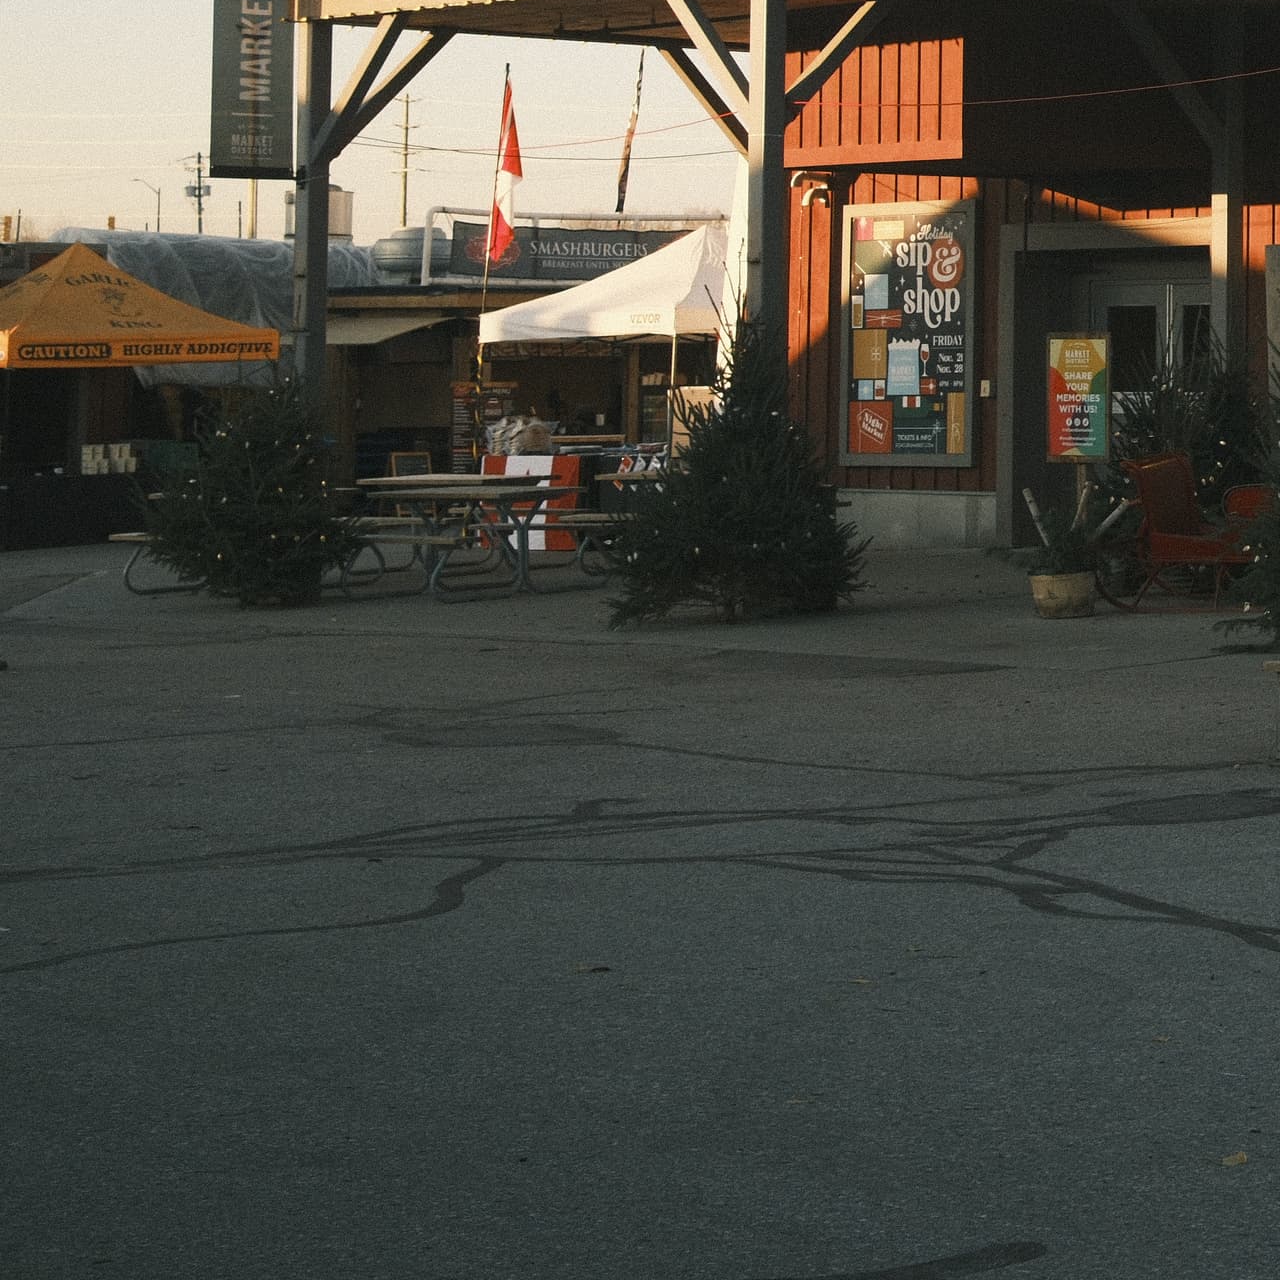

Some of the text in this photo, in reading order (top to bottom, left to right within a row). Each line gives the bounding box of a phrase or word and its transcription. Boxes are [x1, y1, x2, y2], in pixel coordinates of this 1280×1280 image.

[917, 224, 954, 245] Holiday
[529, 241, 649, 257] SMASHBURGERS
[896, 234, 961, 282] sip &
[903, 276, 961, 329] shop
[630, 313, 661, 324] VEVOR
[932, 335, 964, 347] FRIDAY
[21, 341, 273, 359] CAUTION! HIGHLY ADDICTIVE
[1064, 371, 1093, 380] SHARE
[1065, 383, 1089, 391] YOUR
[1056, 394, 1101, 402] MEMORIES
[1059, 405, 1098, 413] WITH US!
[863, 412, 883, 431] Night
[862, 420, 884, 440] Market
